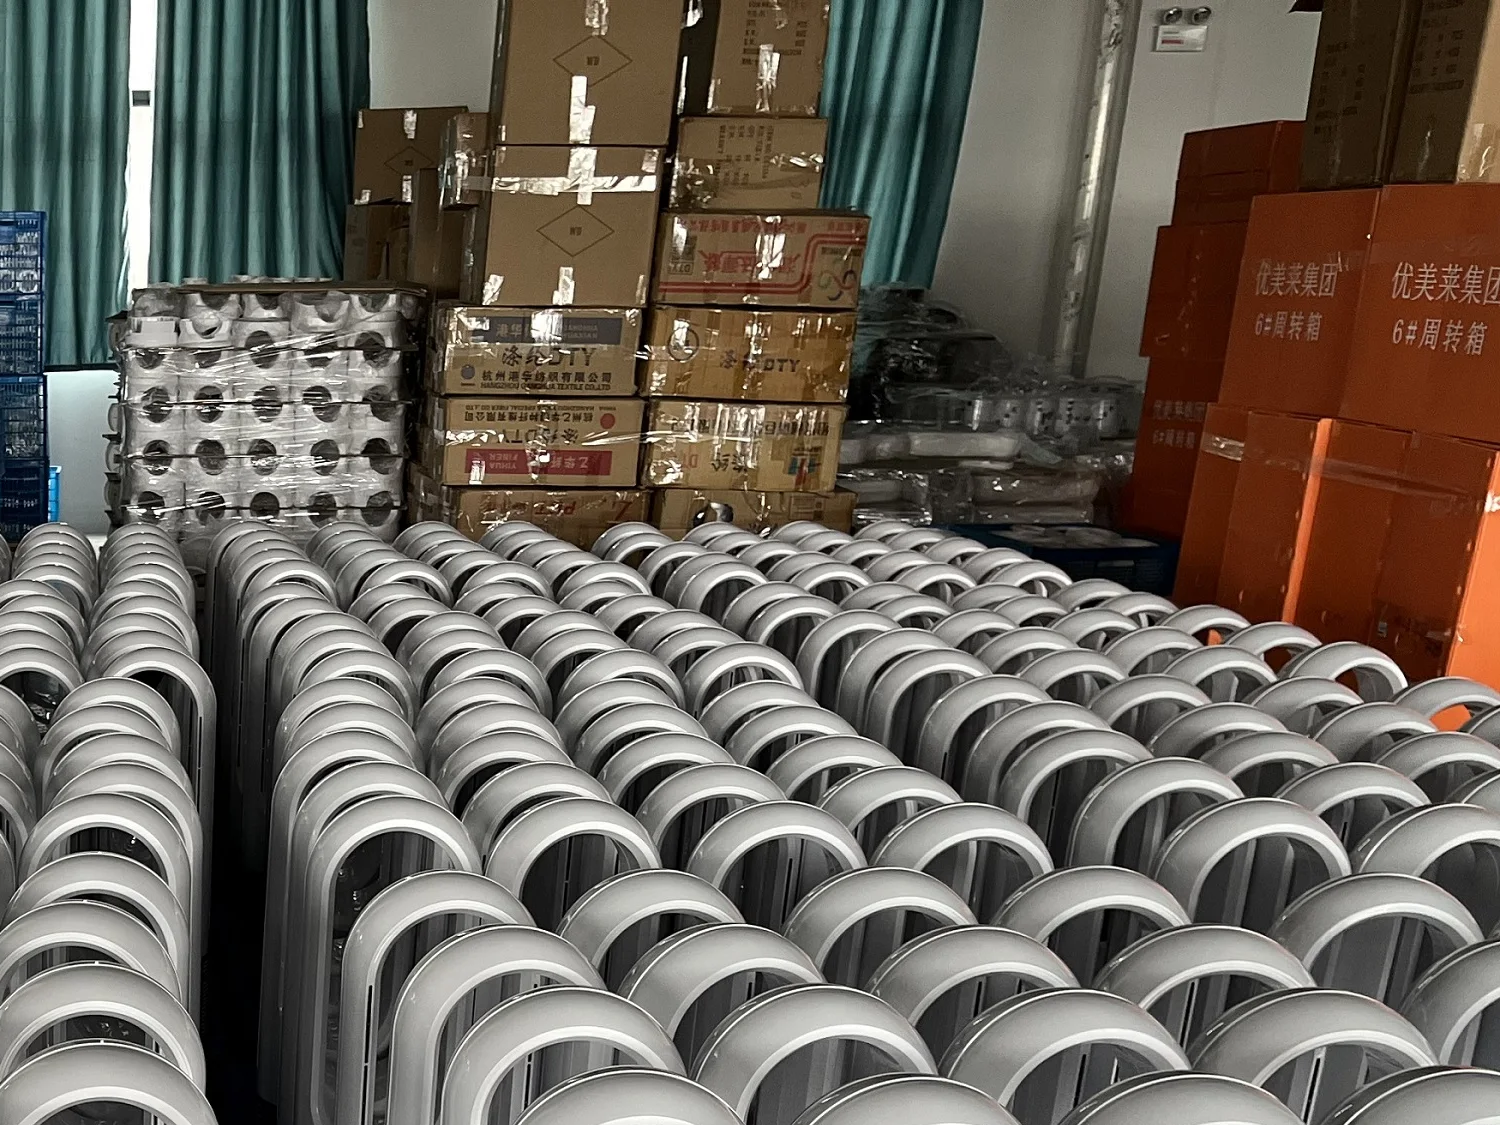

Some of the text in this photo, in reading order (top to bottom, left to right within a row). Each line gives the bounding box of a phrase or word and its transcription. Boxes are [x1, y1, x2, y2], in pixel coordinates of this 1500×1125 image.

[1255, 258, 1339, 297] 优美莱集团
[1391, 261, 1500, 306] 优美莱集团
[1255, 311, 1322, 341] 6#周转箱
[1392, 318, 1488, 355] 6#周转箱
[481, 370, 612, 384] 杭州港华纺织有限公司
[488, 454, 519, 462] FIBER
[489, 462, 517, 470] YIHUA
[538, 456, 589, 469] 乙华纤
